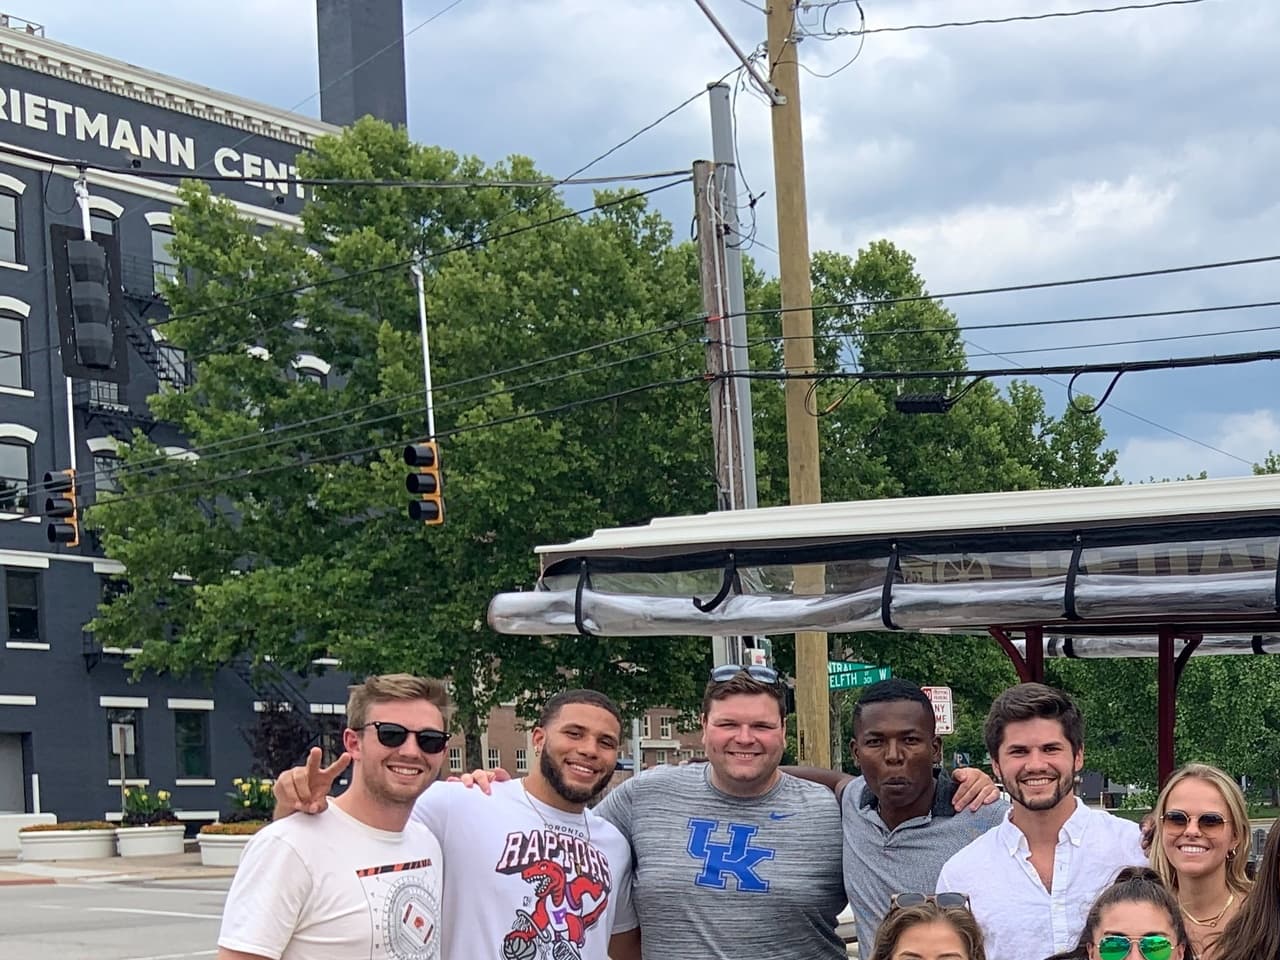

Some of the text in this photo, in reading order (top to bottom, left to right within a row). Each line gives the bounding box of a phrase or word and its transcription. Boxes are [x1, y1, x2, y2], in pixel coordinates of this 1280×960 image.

[214, 147, 305, 199] CENT
[827, 662, 852, 673] NTRAL
[830, 672, 857, 688] ELFTH
[879, 668, 887, 680] W
[934, 703, 945, 713] NY
[936, 714, 948, 723] ME
[543, 823, 585, 838] TORONTO
[495, 829, 612, 894] RAPTORS
[687, 817, 776, 893] UK
